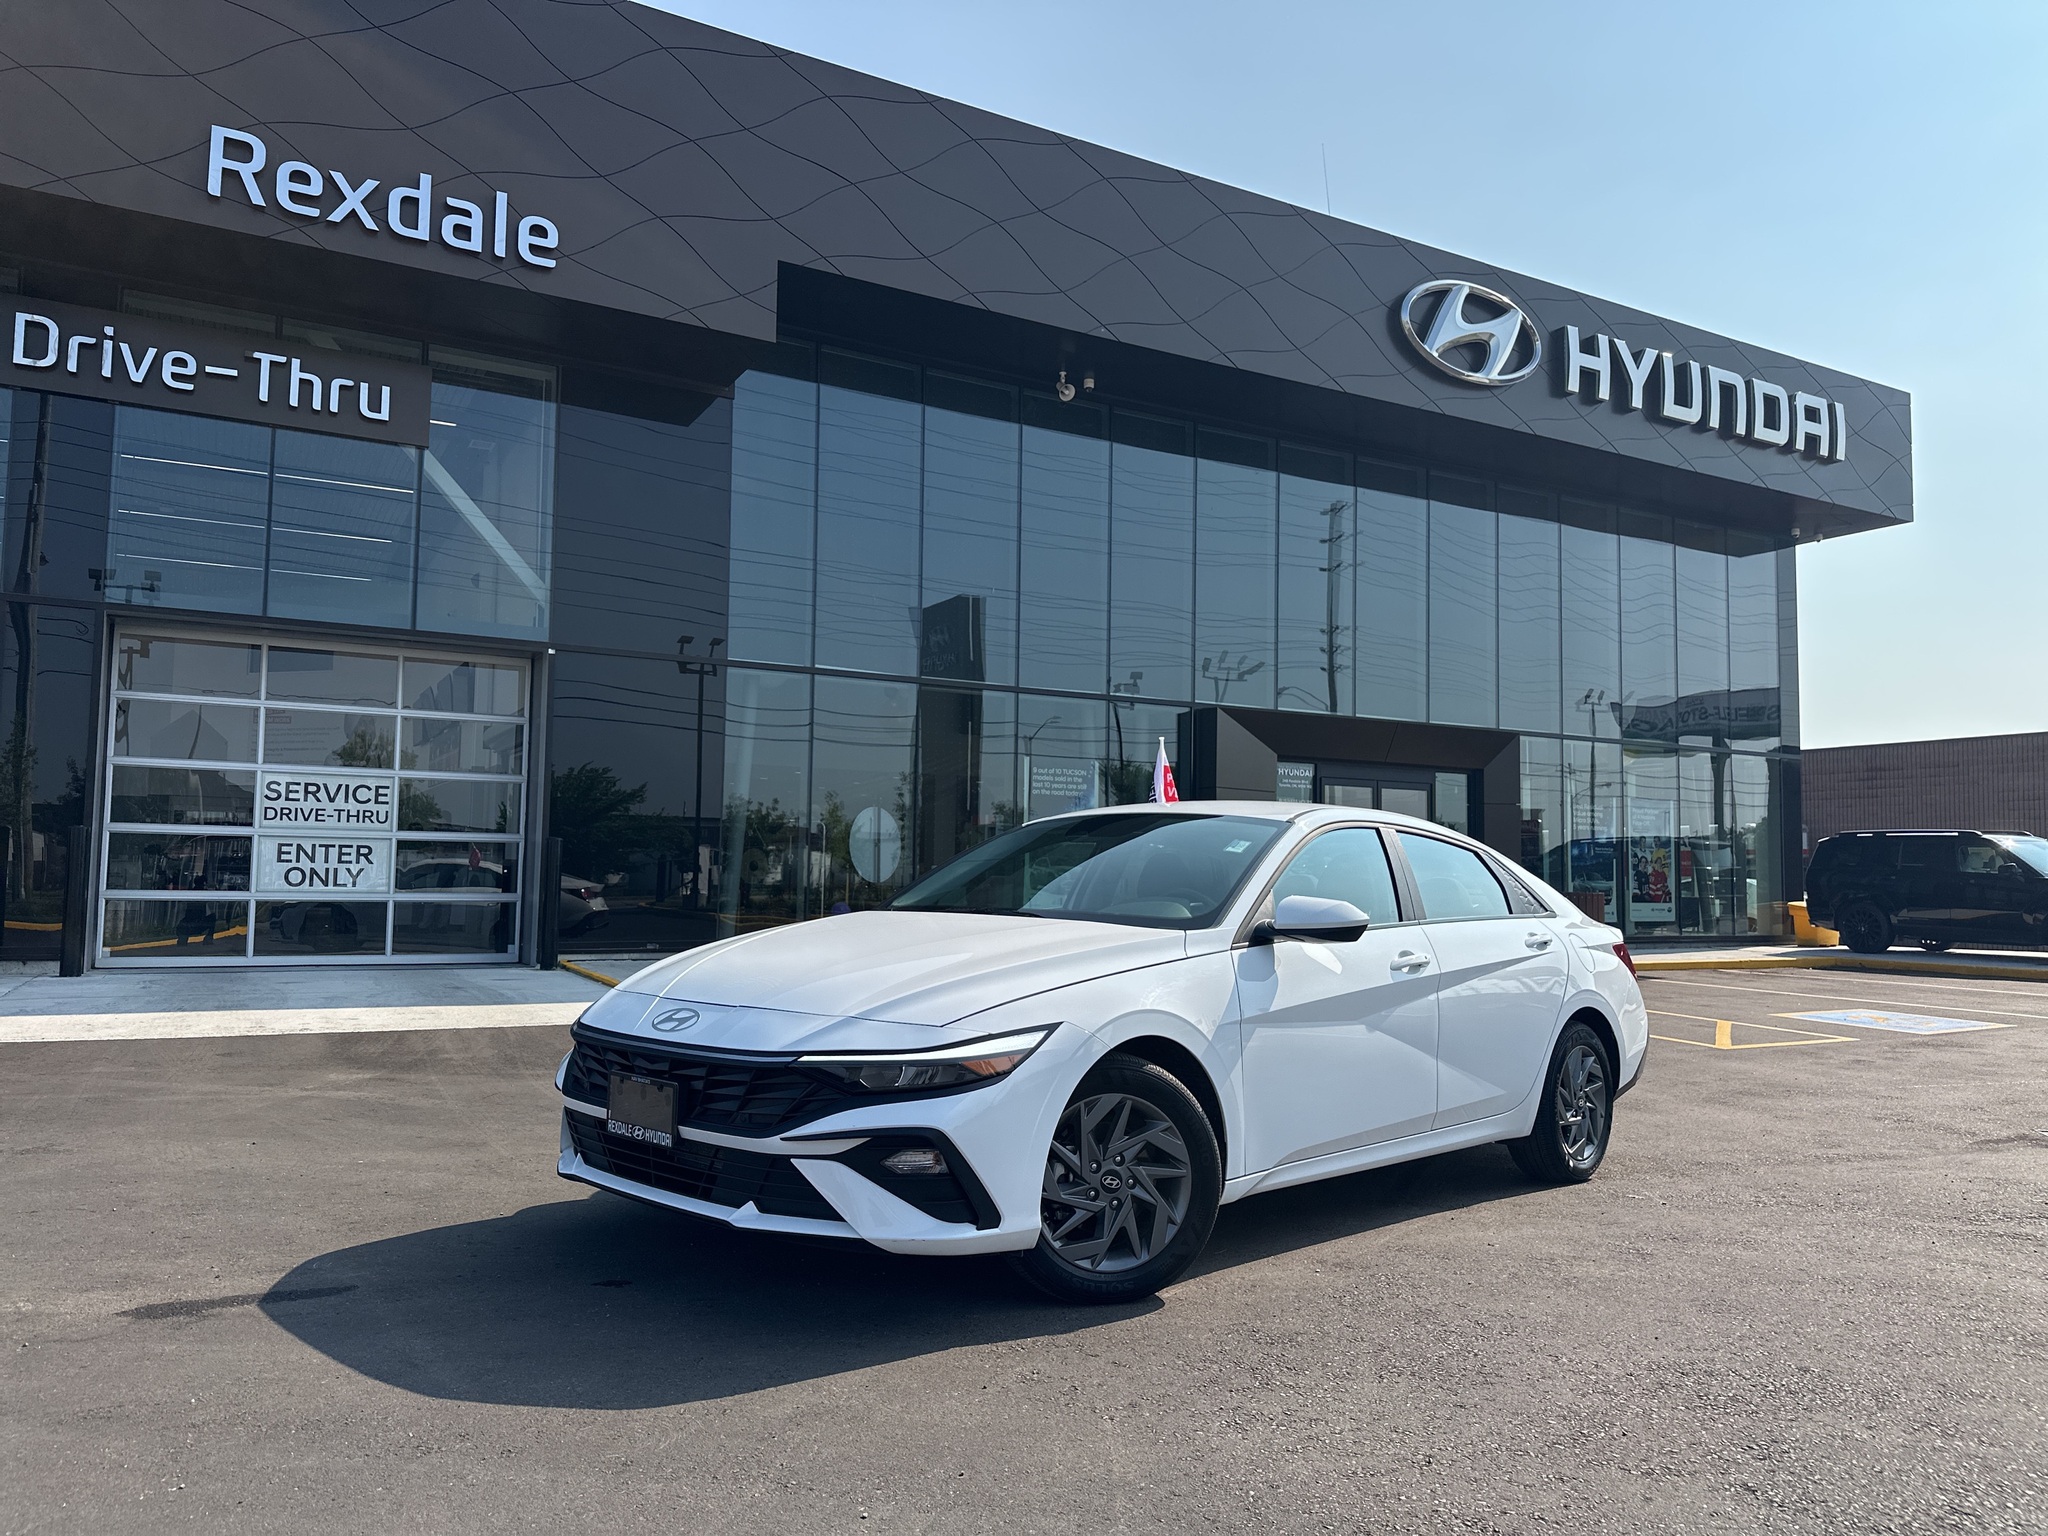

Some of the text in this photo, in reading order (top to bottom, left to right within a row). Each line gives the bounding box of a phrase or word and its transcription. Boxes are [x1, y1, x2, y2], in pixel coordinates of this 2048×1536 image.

[207, 125, 559, 268] Rexdale
[12, 311, 391, 422] Drive-Thru
[1565, 325, 1845, 461] HYUNDAI
[1278, 768, 1312, 777] HYUNDAI
[264, 780, 390, 805] SERVICE
[263, 806, 389, 824] DRIVE-THRU
[276, 842, 374, 865] ENTER
[283, 866, 365, 888] ONLY
[608, 1120, 672, 1147] REXDALE HYUNDAI
